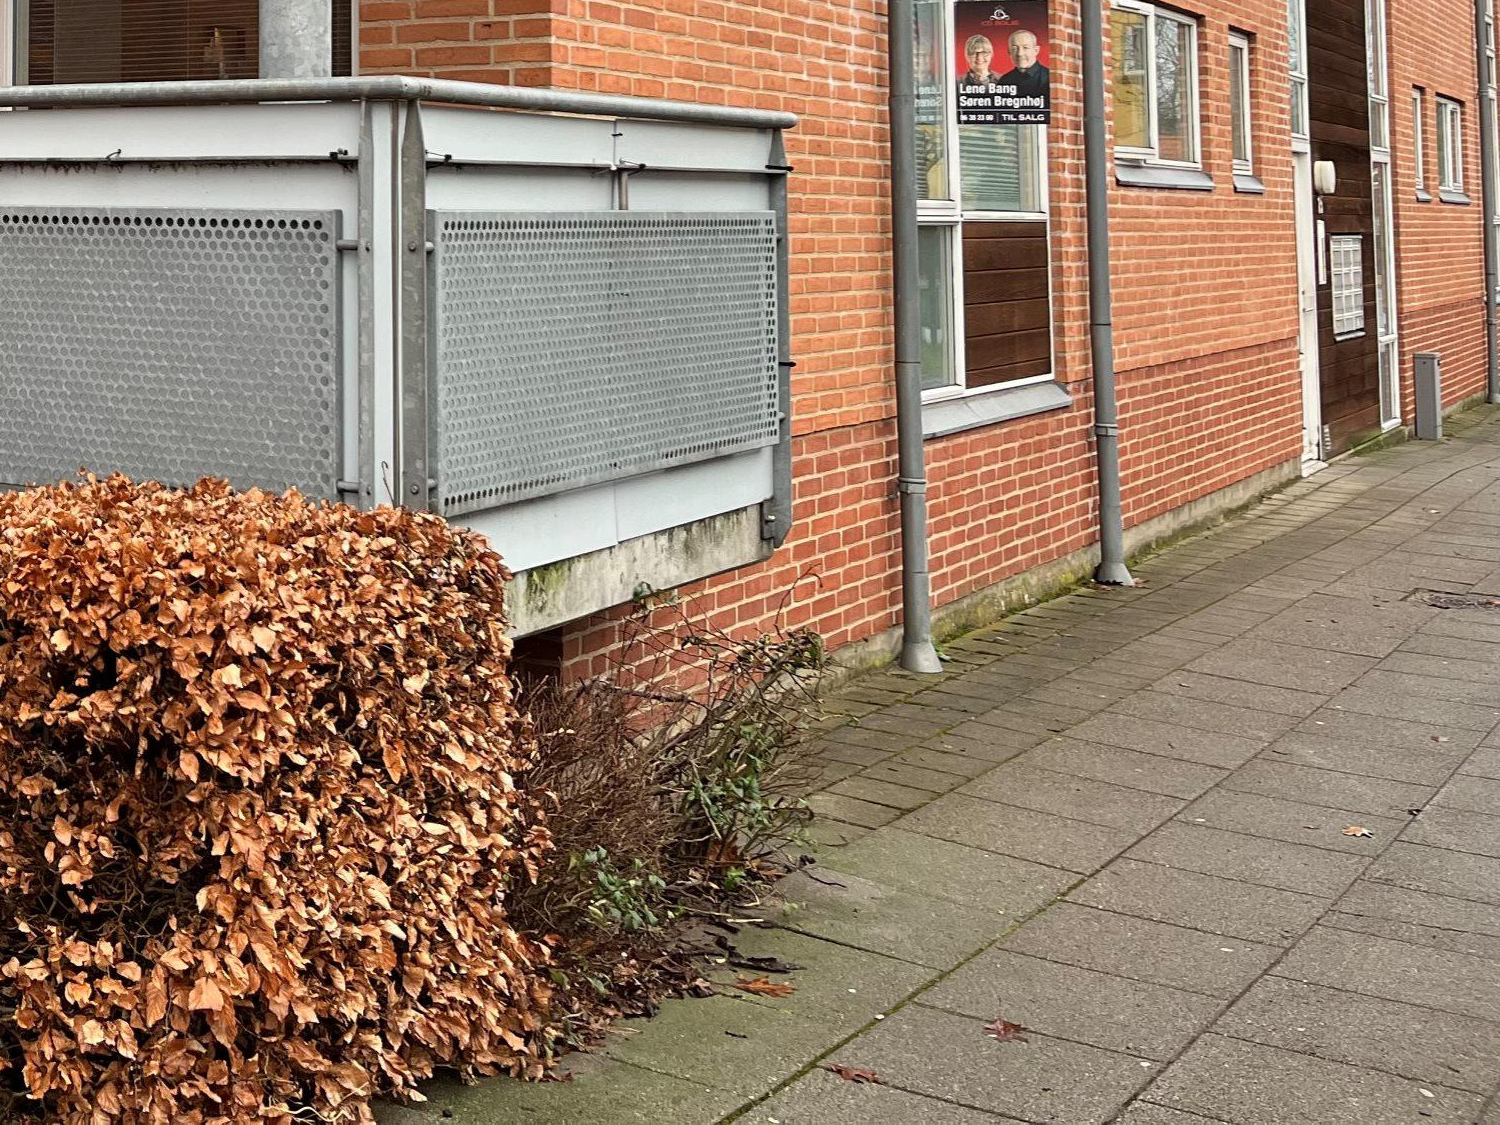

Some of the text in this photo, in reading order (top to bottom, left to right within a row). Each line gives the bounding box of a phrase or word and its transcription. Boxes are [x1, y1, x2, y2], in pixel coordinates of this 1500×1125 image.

[959, 83, 1017, 95] Lene Bang
[959, 95, 1044, 108] Søren Bregnhøj
